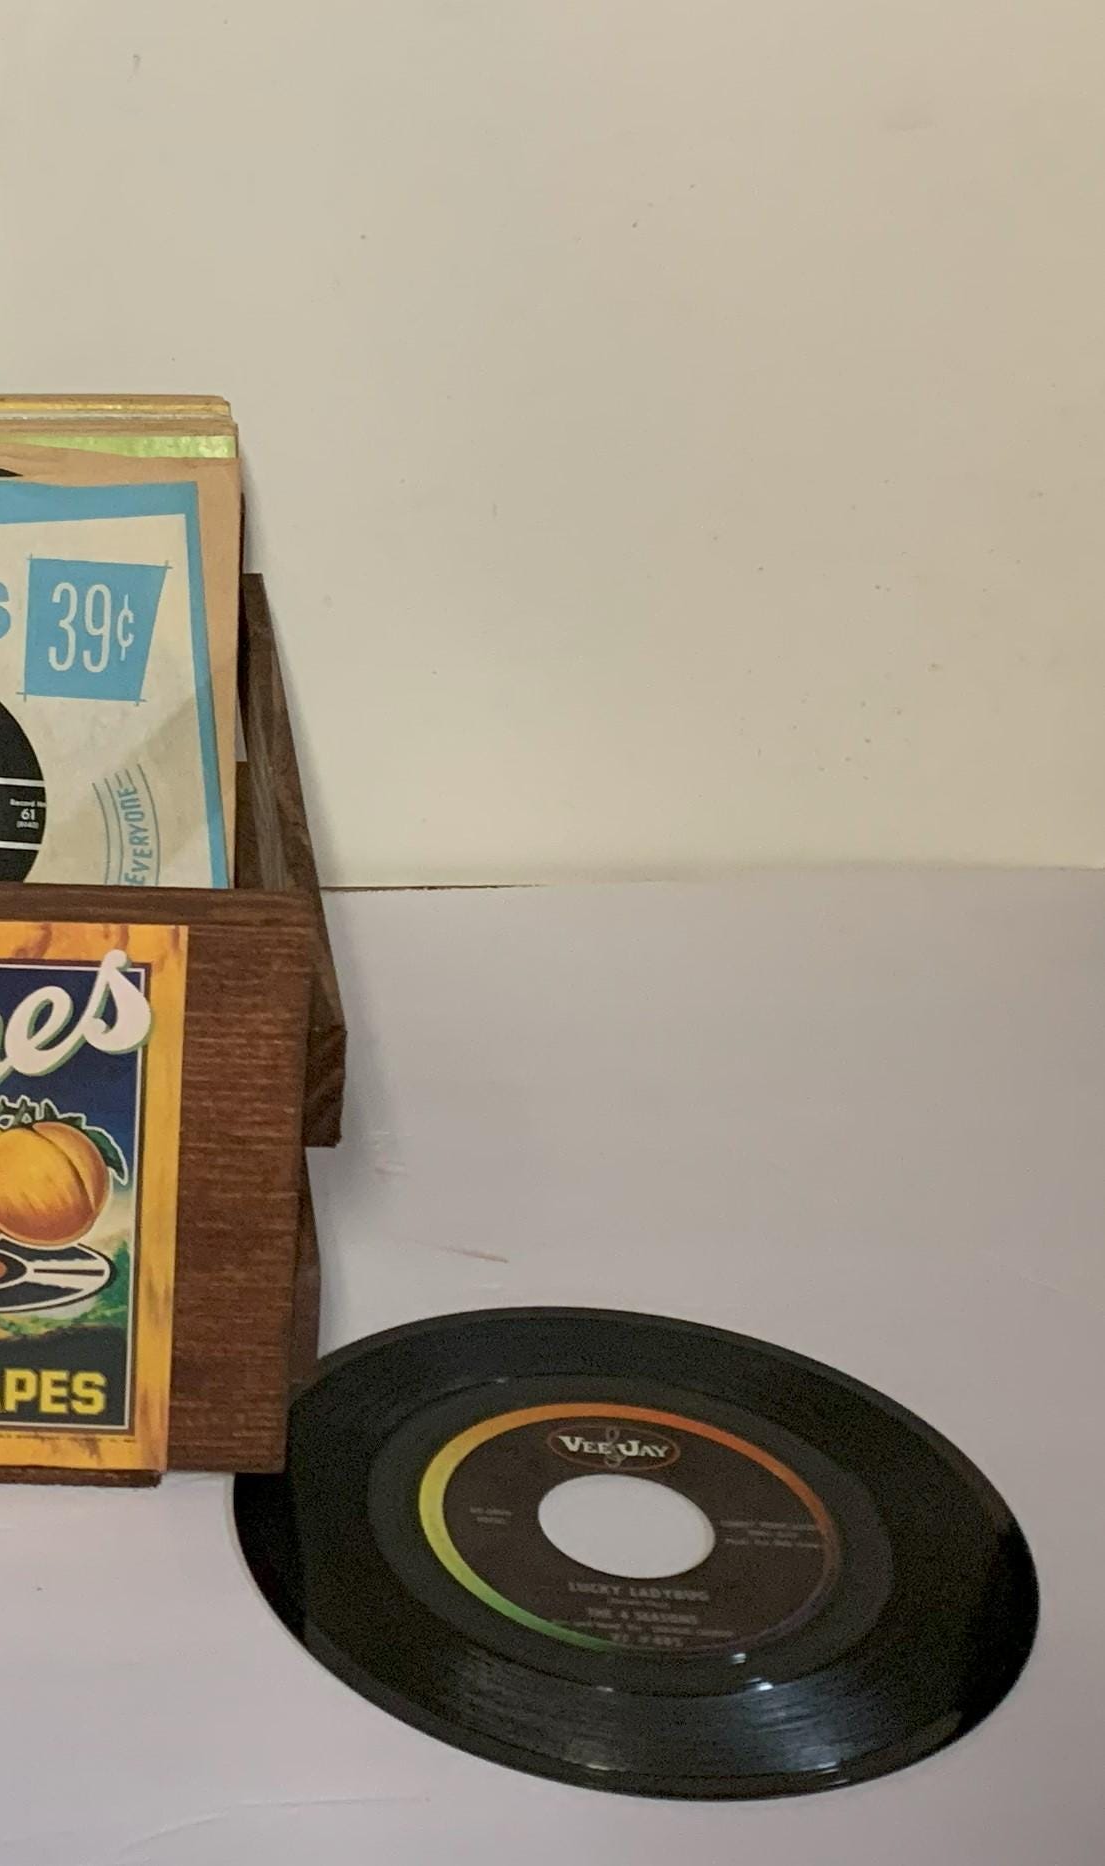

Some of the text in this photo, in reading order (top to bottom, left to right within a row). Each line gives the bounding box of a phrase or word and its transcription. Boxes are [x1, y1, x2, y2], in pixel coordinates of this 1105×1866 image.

[47, 581, 136, 673] 39¢
[21, 808, 35, 820] 61
[116, 787, 152, 885] EVERYONE
[618, 1440, 669, 1458] JAY
